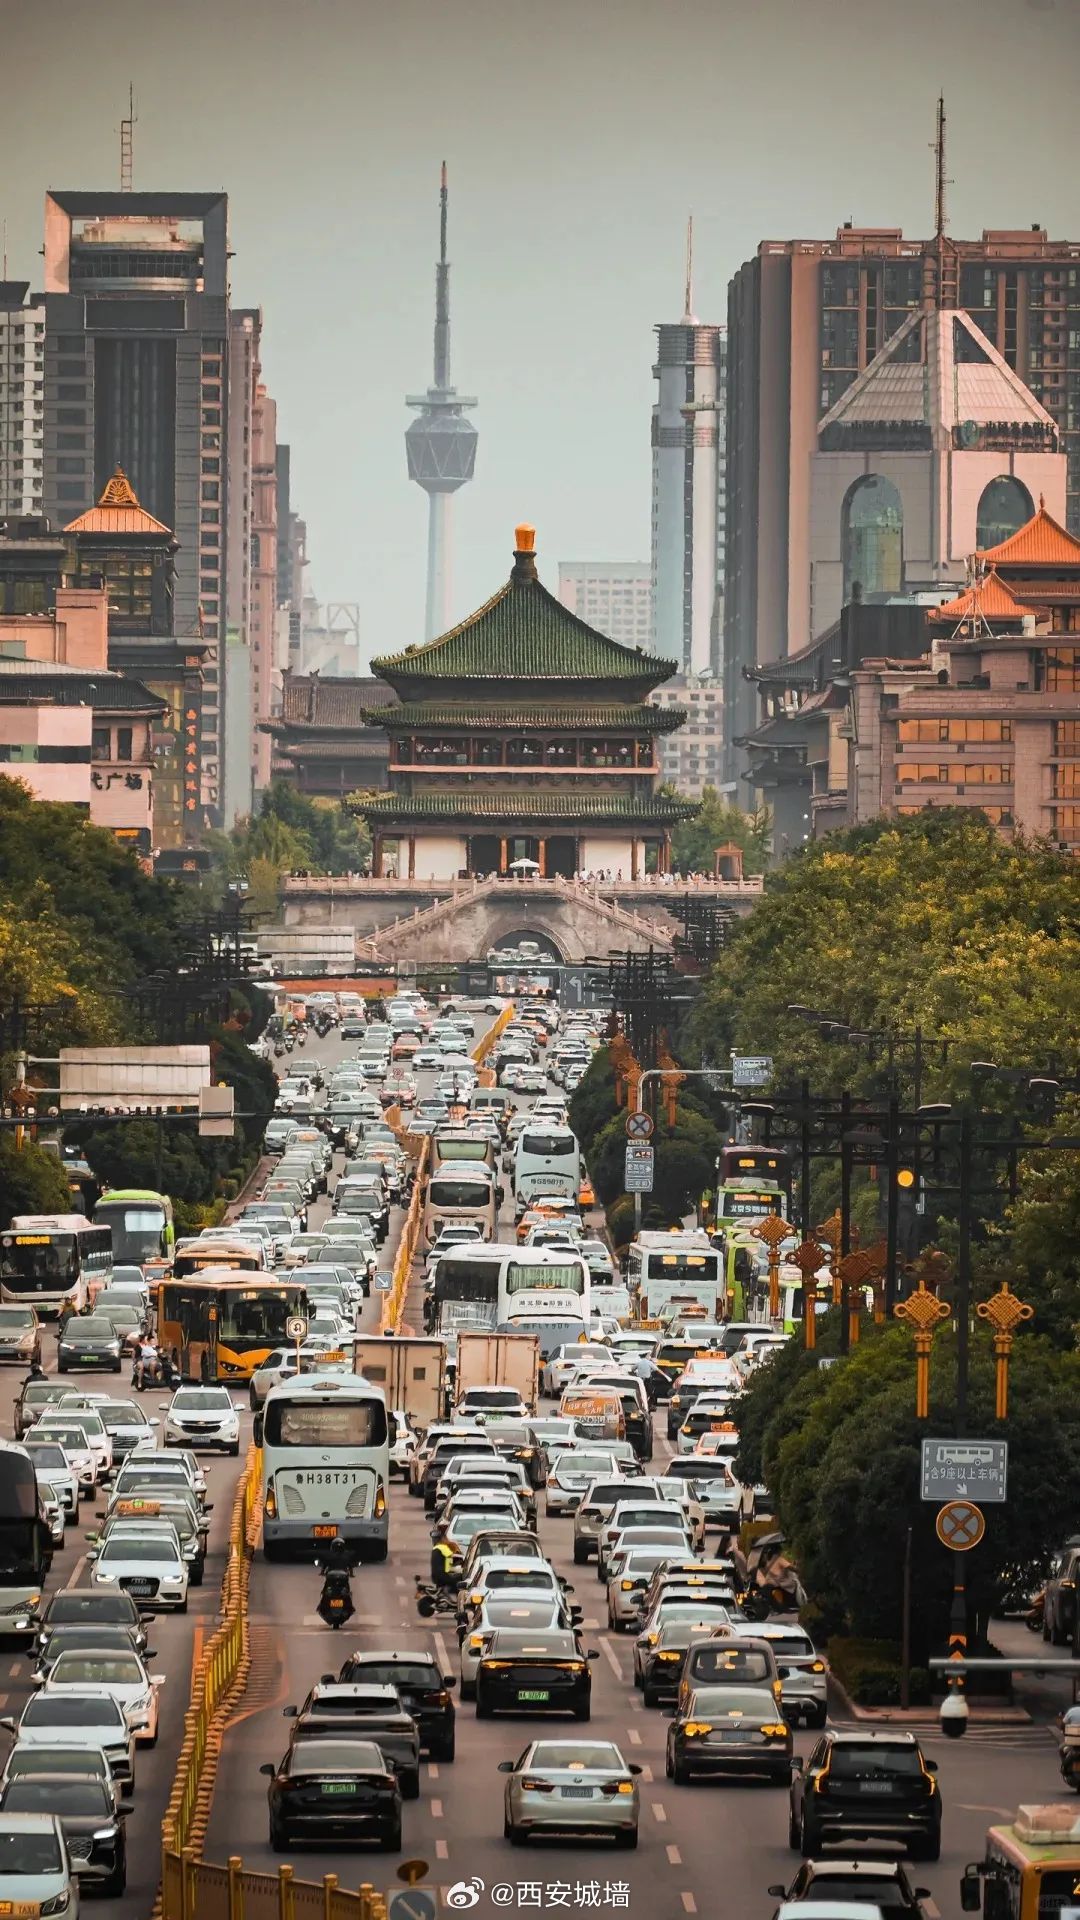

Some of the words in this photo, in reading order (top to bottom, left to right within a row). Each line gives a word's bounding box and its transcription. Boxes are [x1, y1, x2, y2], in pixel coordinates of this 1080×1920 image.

[931, 1466, 999, 1481] 含9座以上车辆
